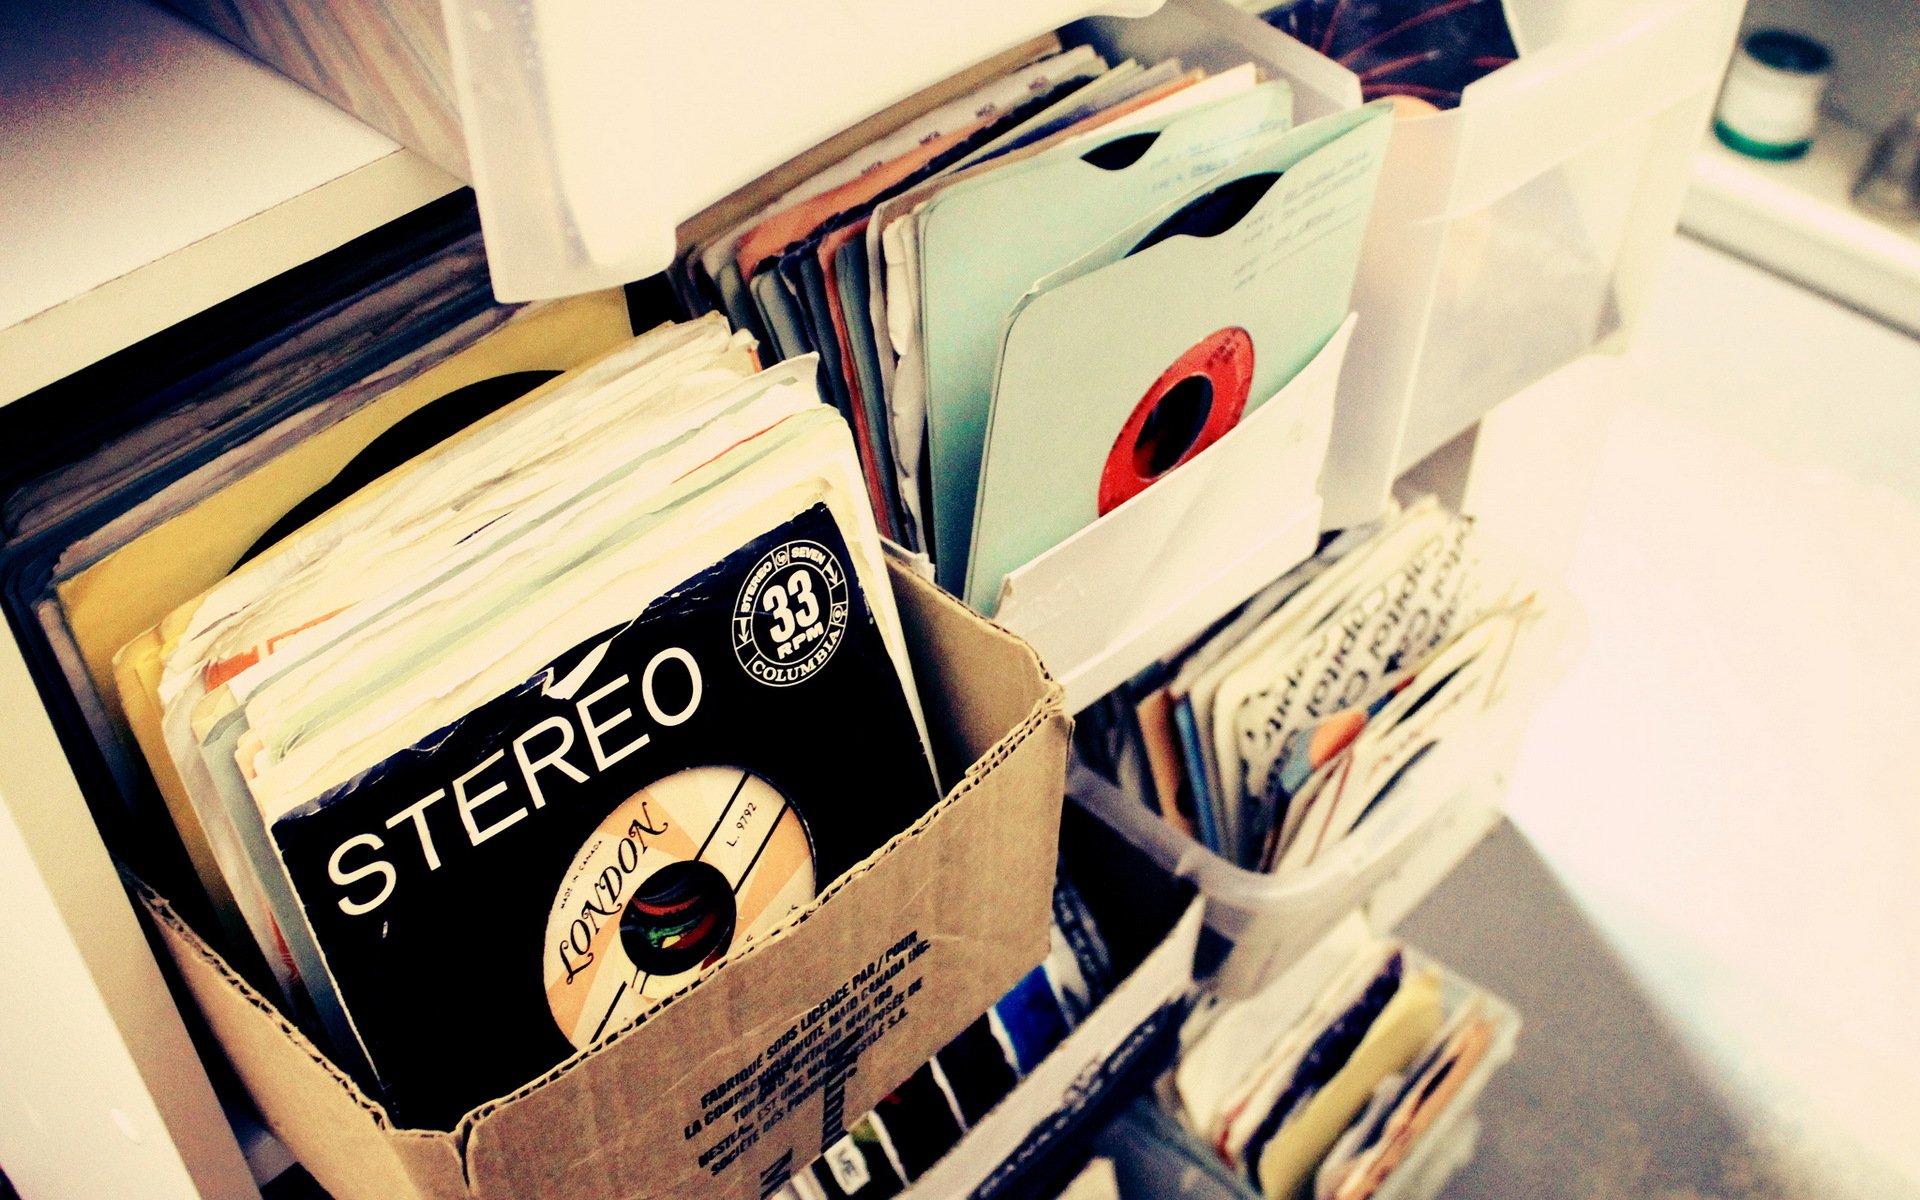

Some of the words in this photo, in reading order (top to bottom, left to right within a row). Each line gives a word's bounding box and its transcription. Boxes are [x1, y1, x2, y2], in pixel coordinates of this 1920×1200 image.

[741, 561, 773, 613] STEREO
[791, 547, 826, 565] SEVEN
[763, 569, 819, 643] 33
[752, 629, 841, 682] COLUMBIA
[777, 622, 824, 660] RPM
[327, 647, 702, 915] STEREO
[736, 802, 758, 830] 9792
[559, 801, 668, 985] LONDON
[561, 887, 573, 909] MADE
[579, 840, 603, 871] CANADA
[684, 1123, 703, 1140] LA
[829, 995, 858, 1029] MAID
[861, 961, 905, 1000] CANADA
[758, 1099, 777, 1121] EST
[781, 1075, 804, 1100] UNE
[908, 976, 923, 996] DE
[766, 1025, 798, 1060] SOUS
[801, 982, 849, 1031] LICENCE
[794, 1030, 842, 1073] ONTARIO
[763, 1109, 784, 1133] DES
